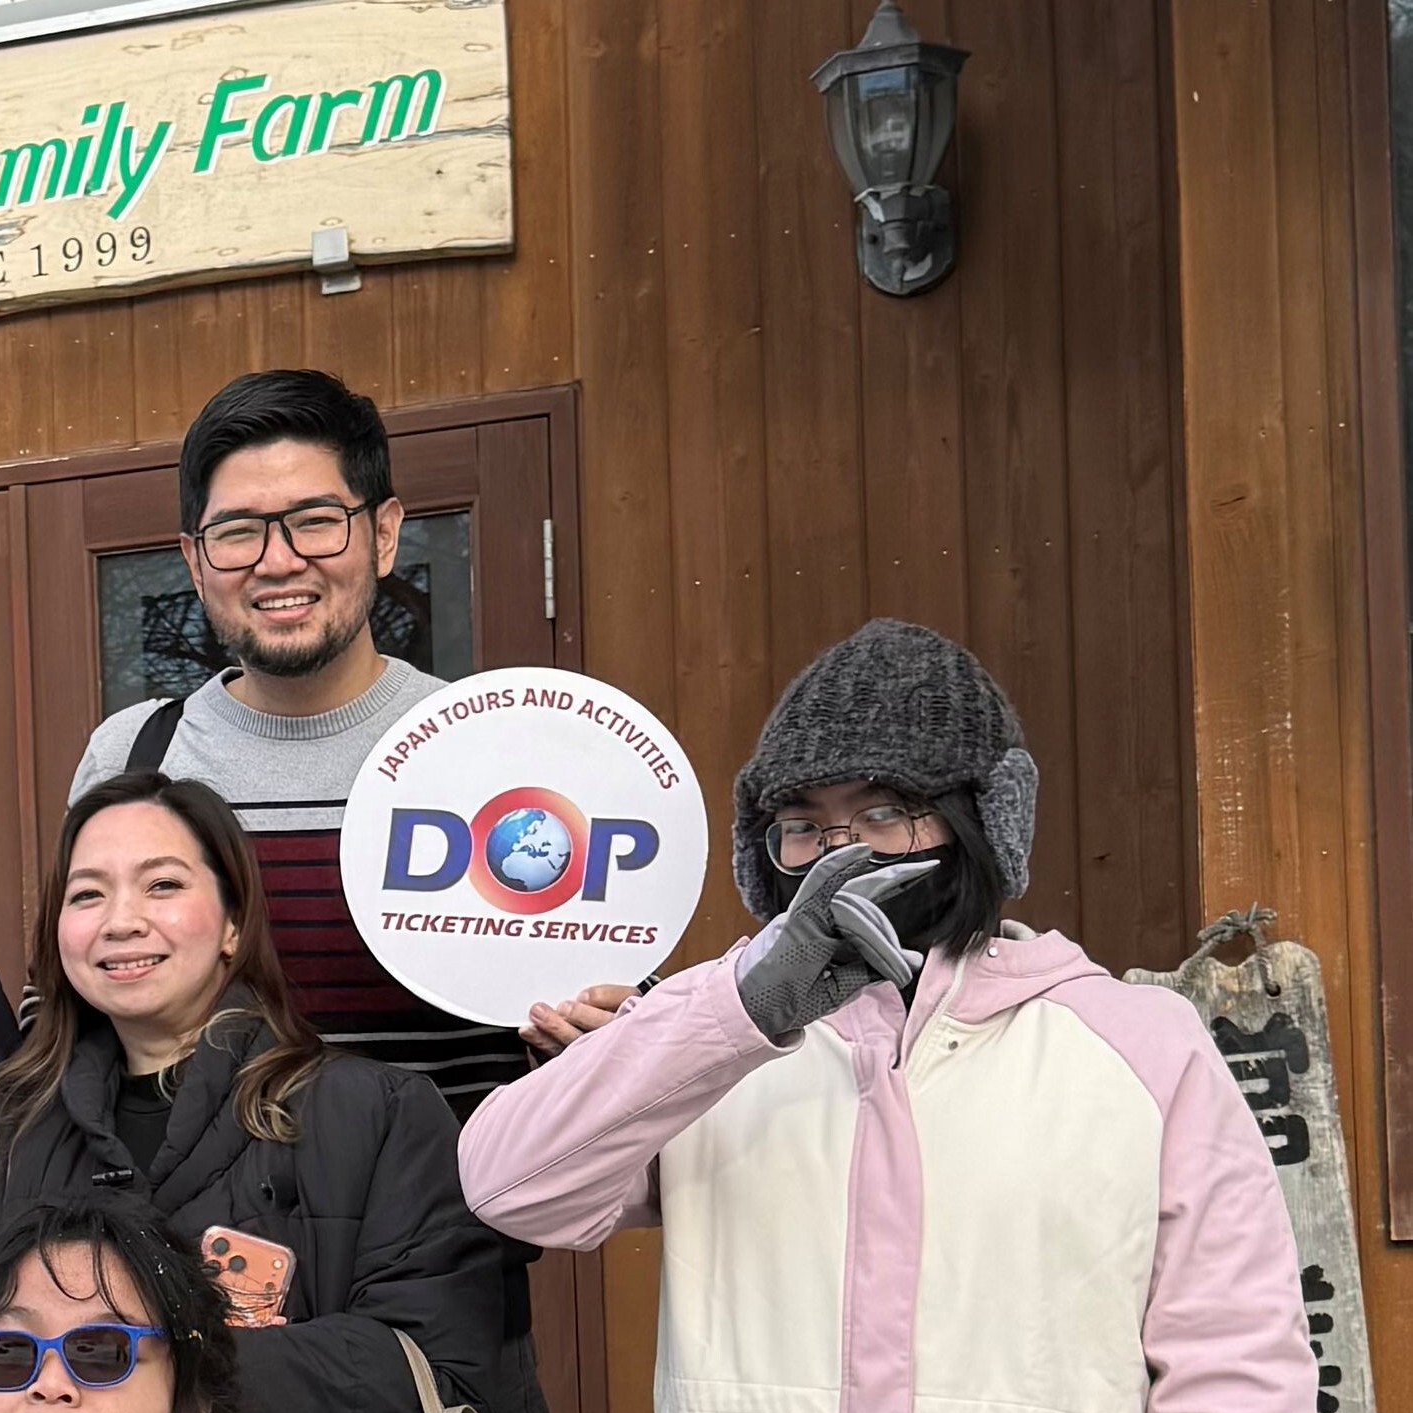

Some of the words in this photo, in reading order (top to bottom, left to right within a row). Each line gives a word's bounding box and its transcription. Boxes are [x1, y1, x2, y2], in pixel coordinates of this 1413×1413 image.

[194, 69, 444, 173] Farm
[30, 226, 151, 279] 1999
[377, 717, 440, 782] JAPAN
[439, 688, 515, 727] TOURS
[521, 688, 574, 712] AND
[576, 698, 681, 790] ACTIVITIES
[381, 786, 661, 916] DOP
[381, 912, 525, 938] TICKETING
[529, 920, 658, 945] SERVICES
